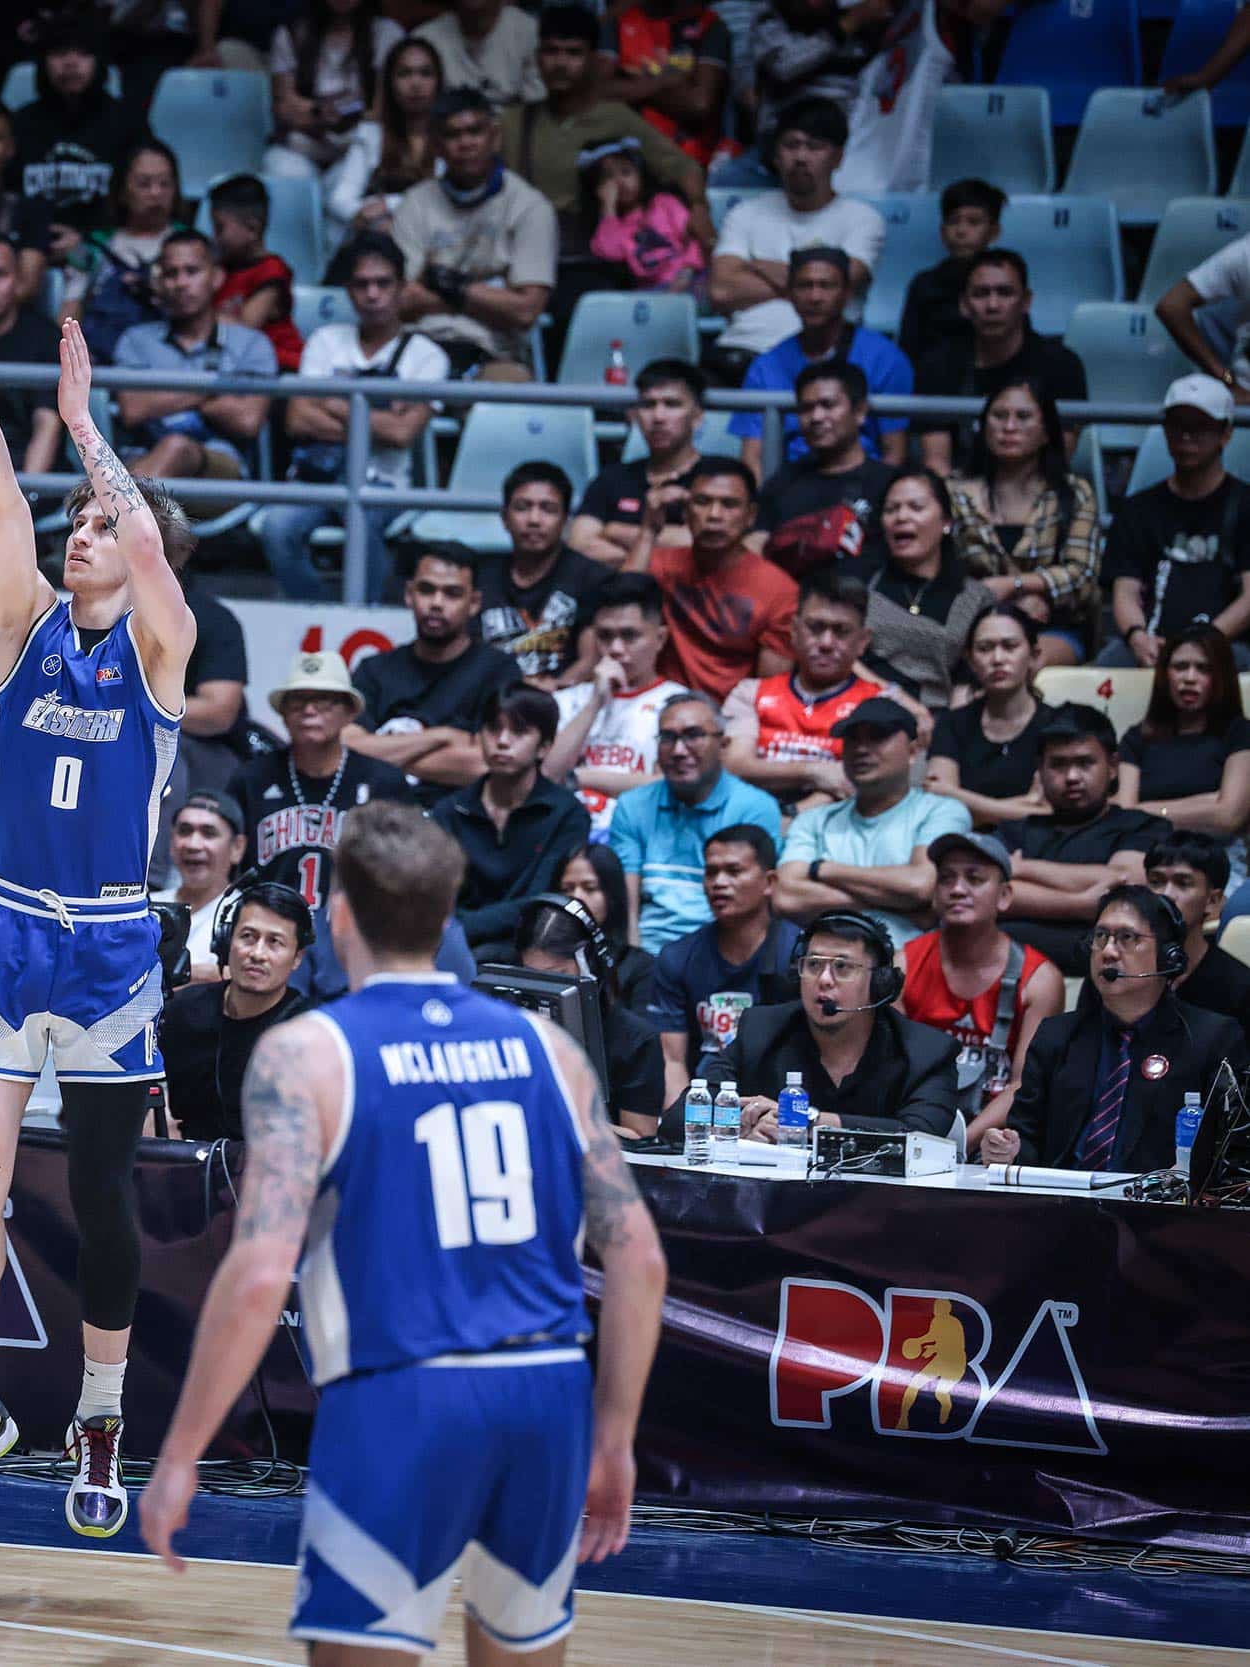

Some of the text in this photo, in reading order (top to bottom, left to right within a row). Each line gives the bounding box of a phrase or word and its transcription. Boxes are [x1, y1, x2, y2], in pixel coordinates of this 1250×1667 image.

[22, 697, 125, 742] EASTERN
[51, 756, 83, 810] 0
[414, 1100, 537, 1250] 19
[768, 1276, 1109, 1456] PBA
